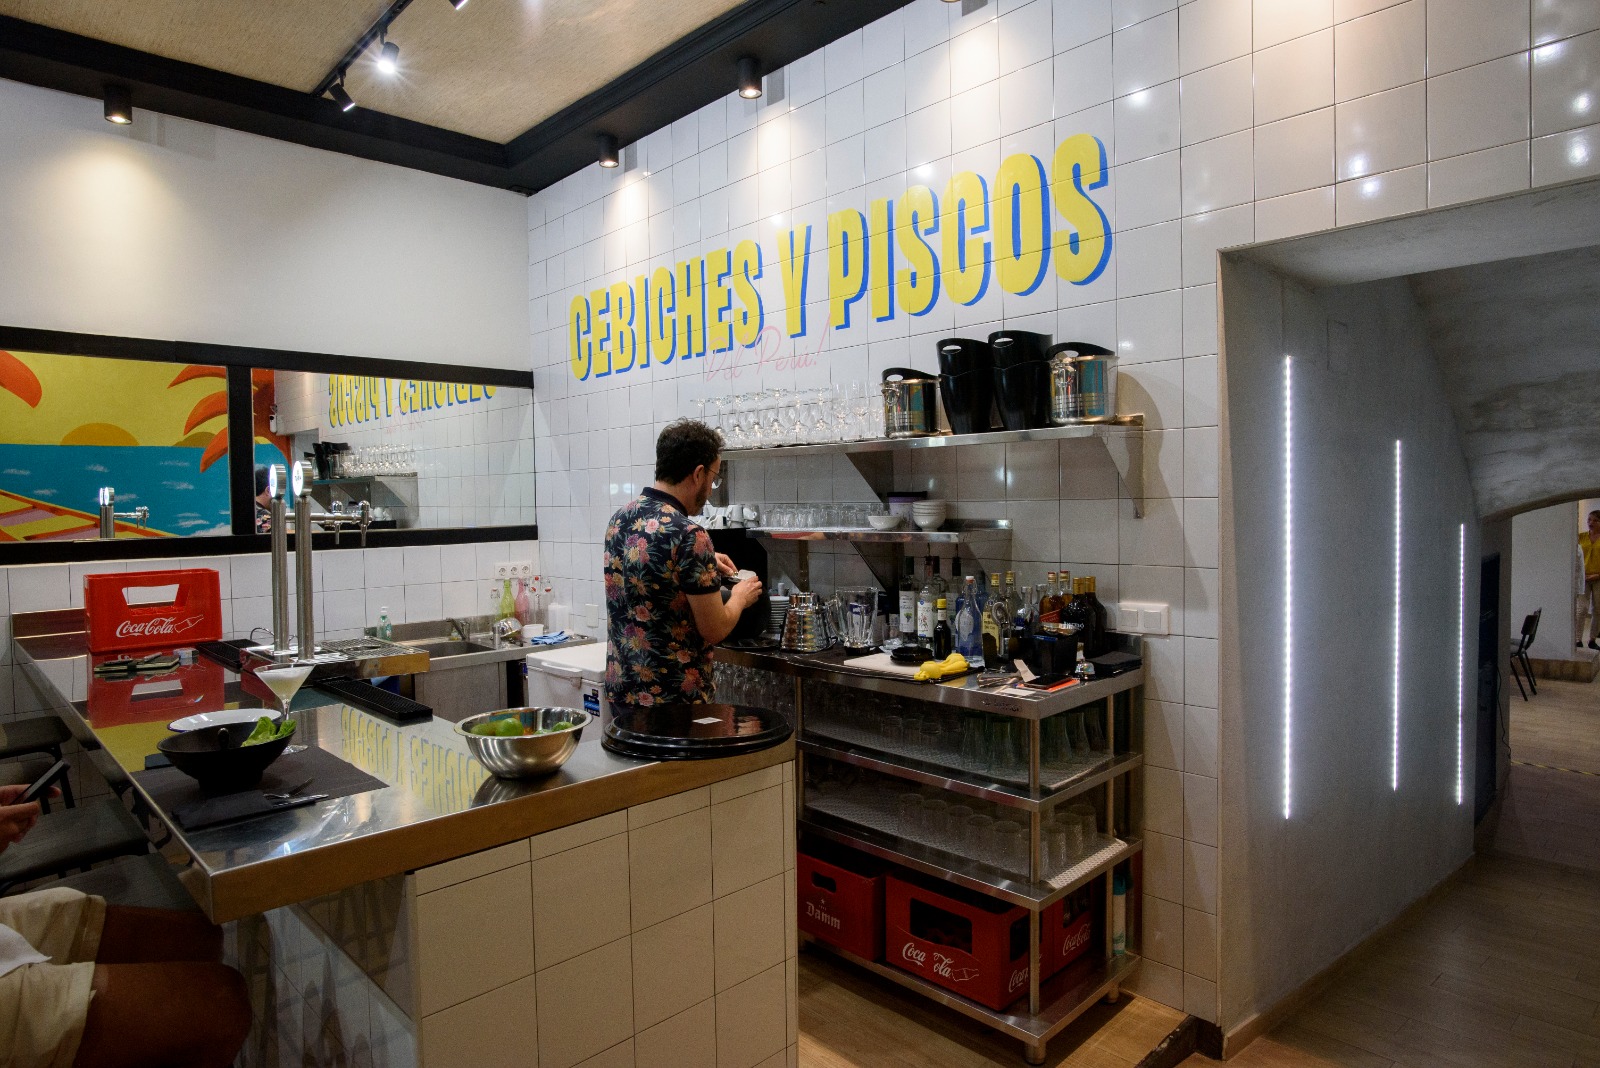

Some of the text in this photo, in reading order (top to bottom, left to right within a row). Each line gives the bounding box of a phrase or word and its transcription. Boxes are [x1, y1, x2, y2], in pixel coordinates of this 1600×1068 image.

[569, 133, 1113, 382] CEBICHES Y PISCOS
[805, 901, 841, 930] Damm
